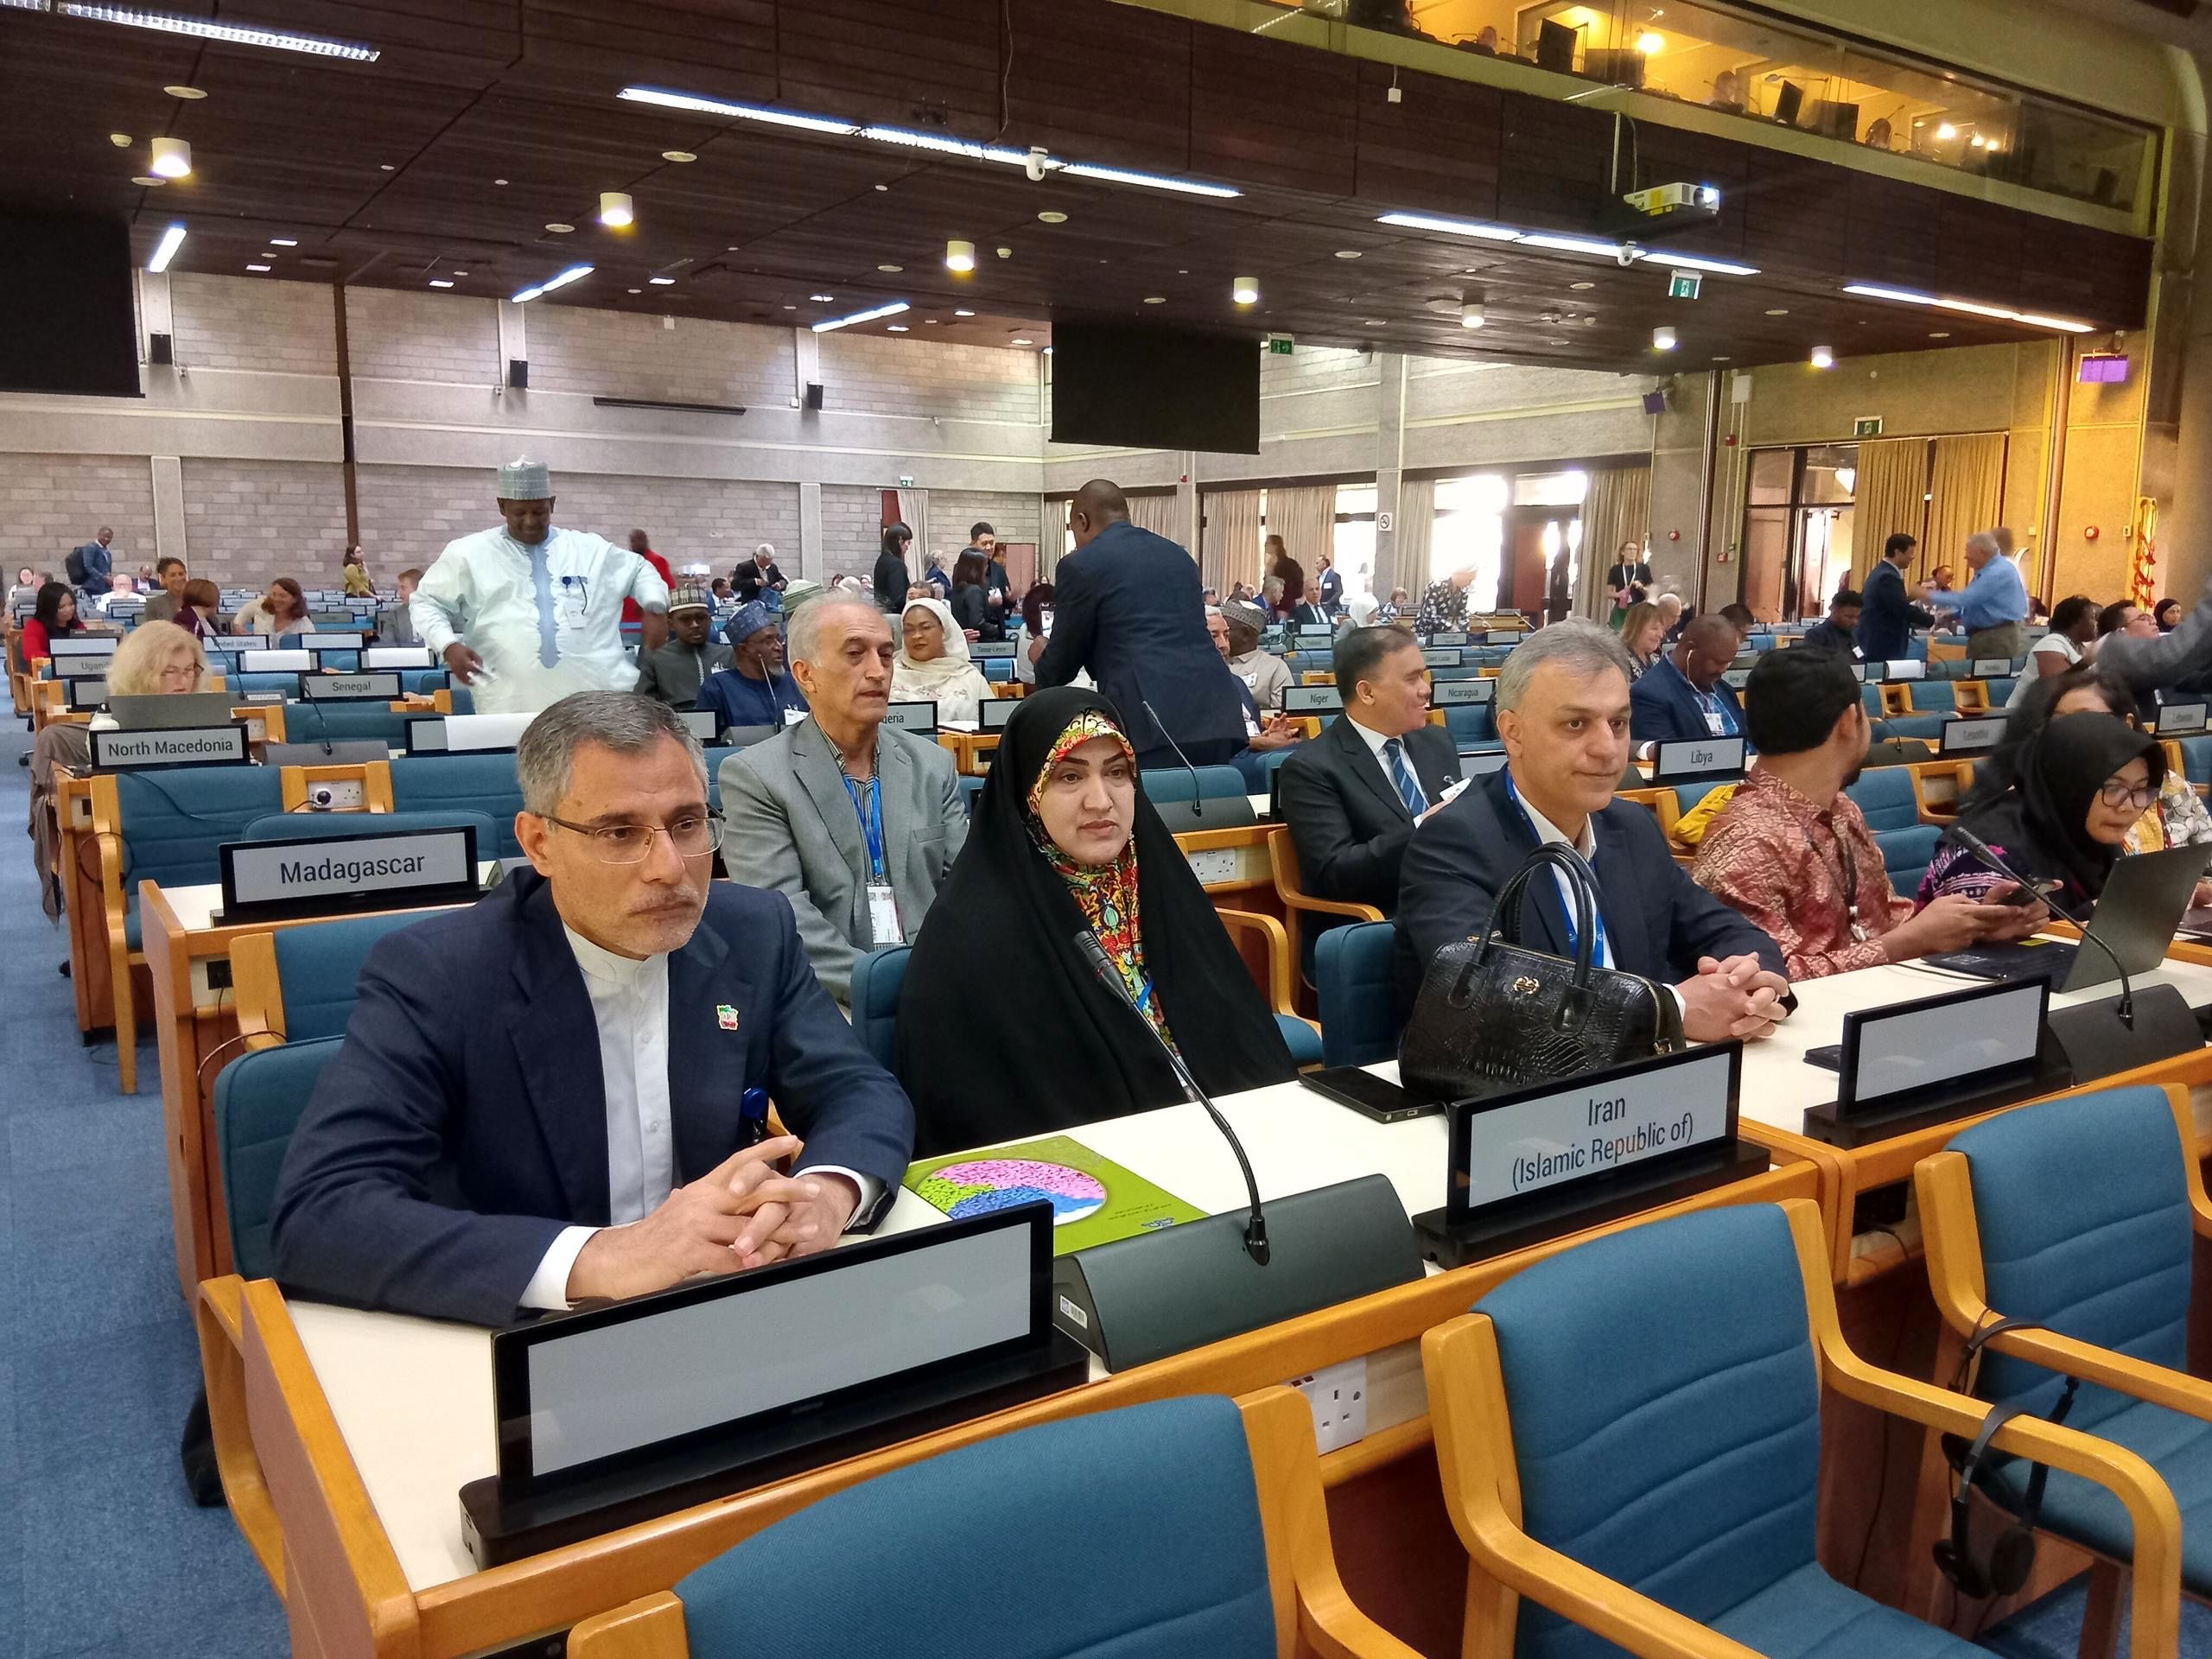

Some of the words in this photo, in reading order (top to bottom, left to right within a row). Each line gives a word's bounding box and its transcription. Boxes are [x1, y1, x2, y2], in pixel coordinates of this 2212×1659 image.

[81, 662, 110, 671] Ugan
[333, 681, 372, 692] Senegal
[1448, 688, 1479, 697] Nicaragua
[1310, 693, 1330, 703] Niger
[882, 712, 905, 724] geria
[108, 742, 150, 757] North
[155, 738, 233, 754] Macedonia
[1691, 750, 1713, 766] Libya
[280, 855, 425, 884] Madagascar
[1588, 1097, 1626, 1127] Iran
[1513, 1143, 1585, 1192] (Islamic
[1592, 1122, 1665, 1164] Republic
[1670, 1112, 1694, 1145] of)
